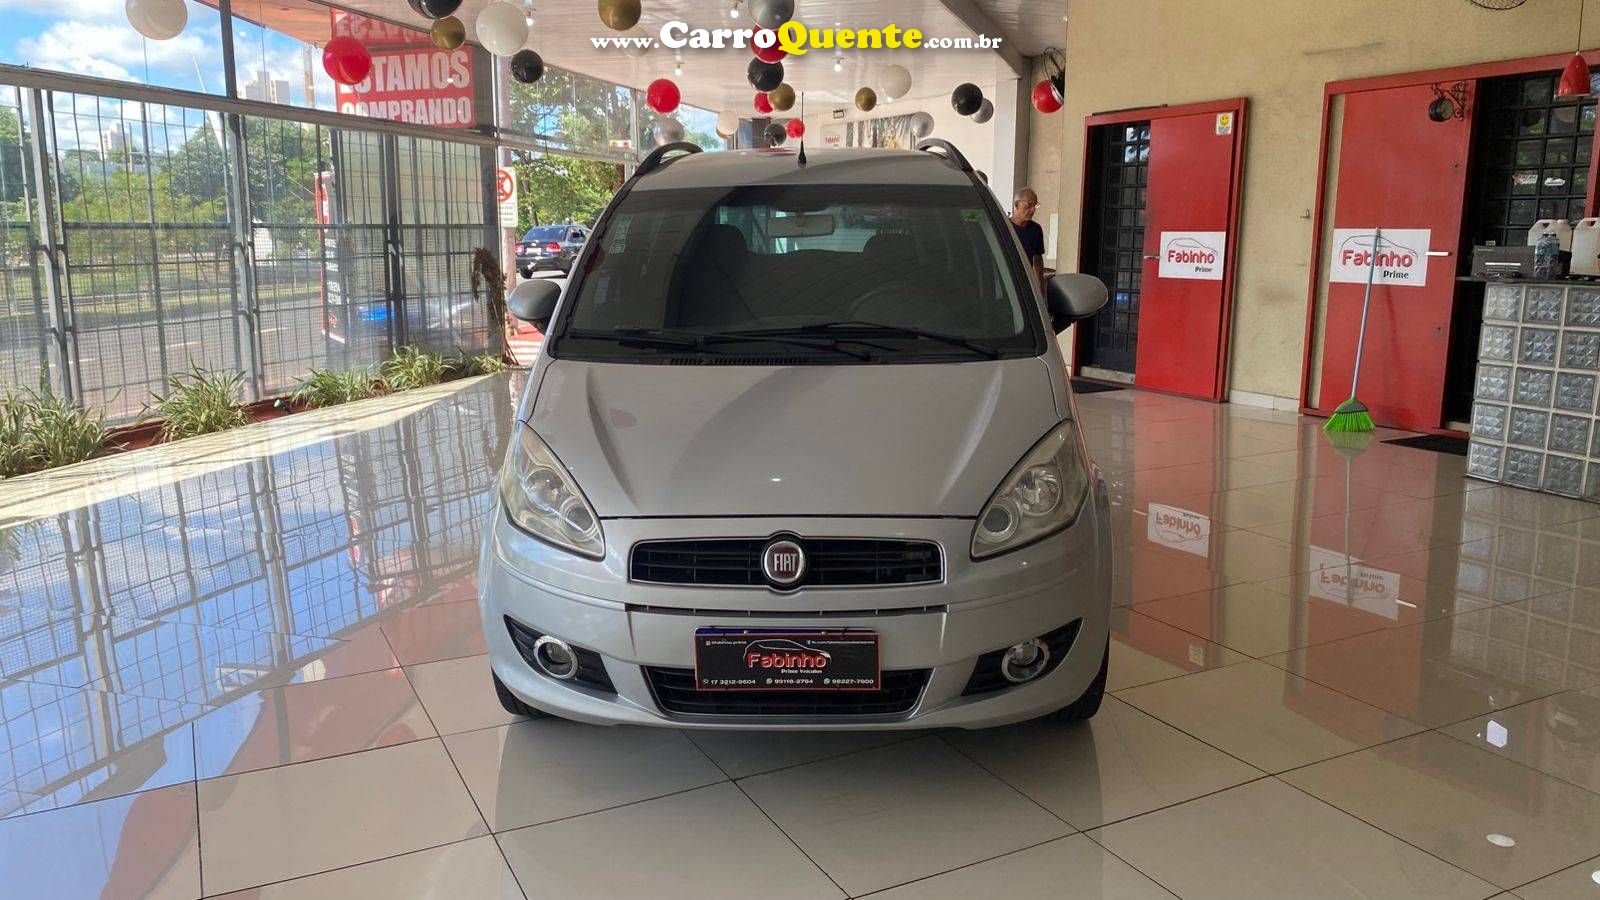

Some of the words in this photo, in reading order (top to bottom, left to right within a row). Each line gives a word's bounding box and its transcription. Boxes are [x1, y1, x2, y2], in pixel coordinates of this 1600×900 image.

[338, 51, 470, 94] TAMOS
[1167, 250, 1215, 264] Fabinho
[1383, 270, 1409, 279] Prime
[773, 553, 798, 572] FIAT
[748, 653, 827, 668] Fabinho
